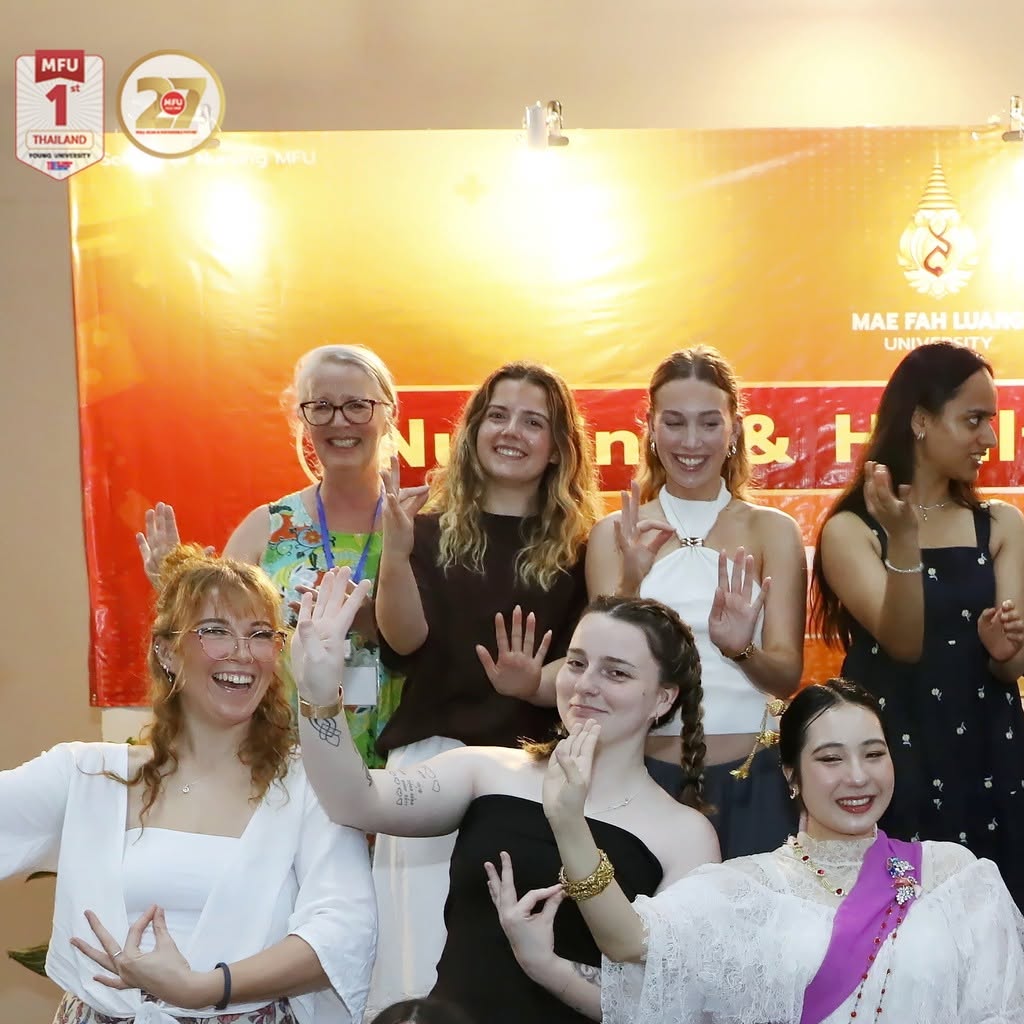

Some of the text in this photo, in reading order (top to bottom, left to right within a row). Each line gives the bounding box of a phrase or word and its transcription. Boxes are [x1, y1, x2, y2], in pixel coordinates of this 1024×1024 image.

[852, 313, 898, 330] MAE
[904, 312, 948, 330] FAH
[743, 414, 795, 465] &
